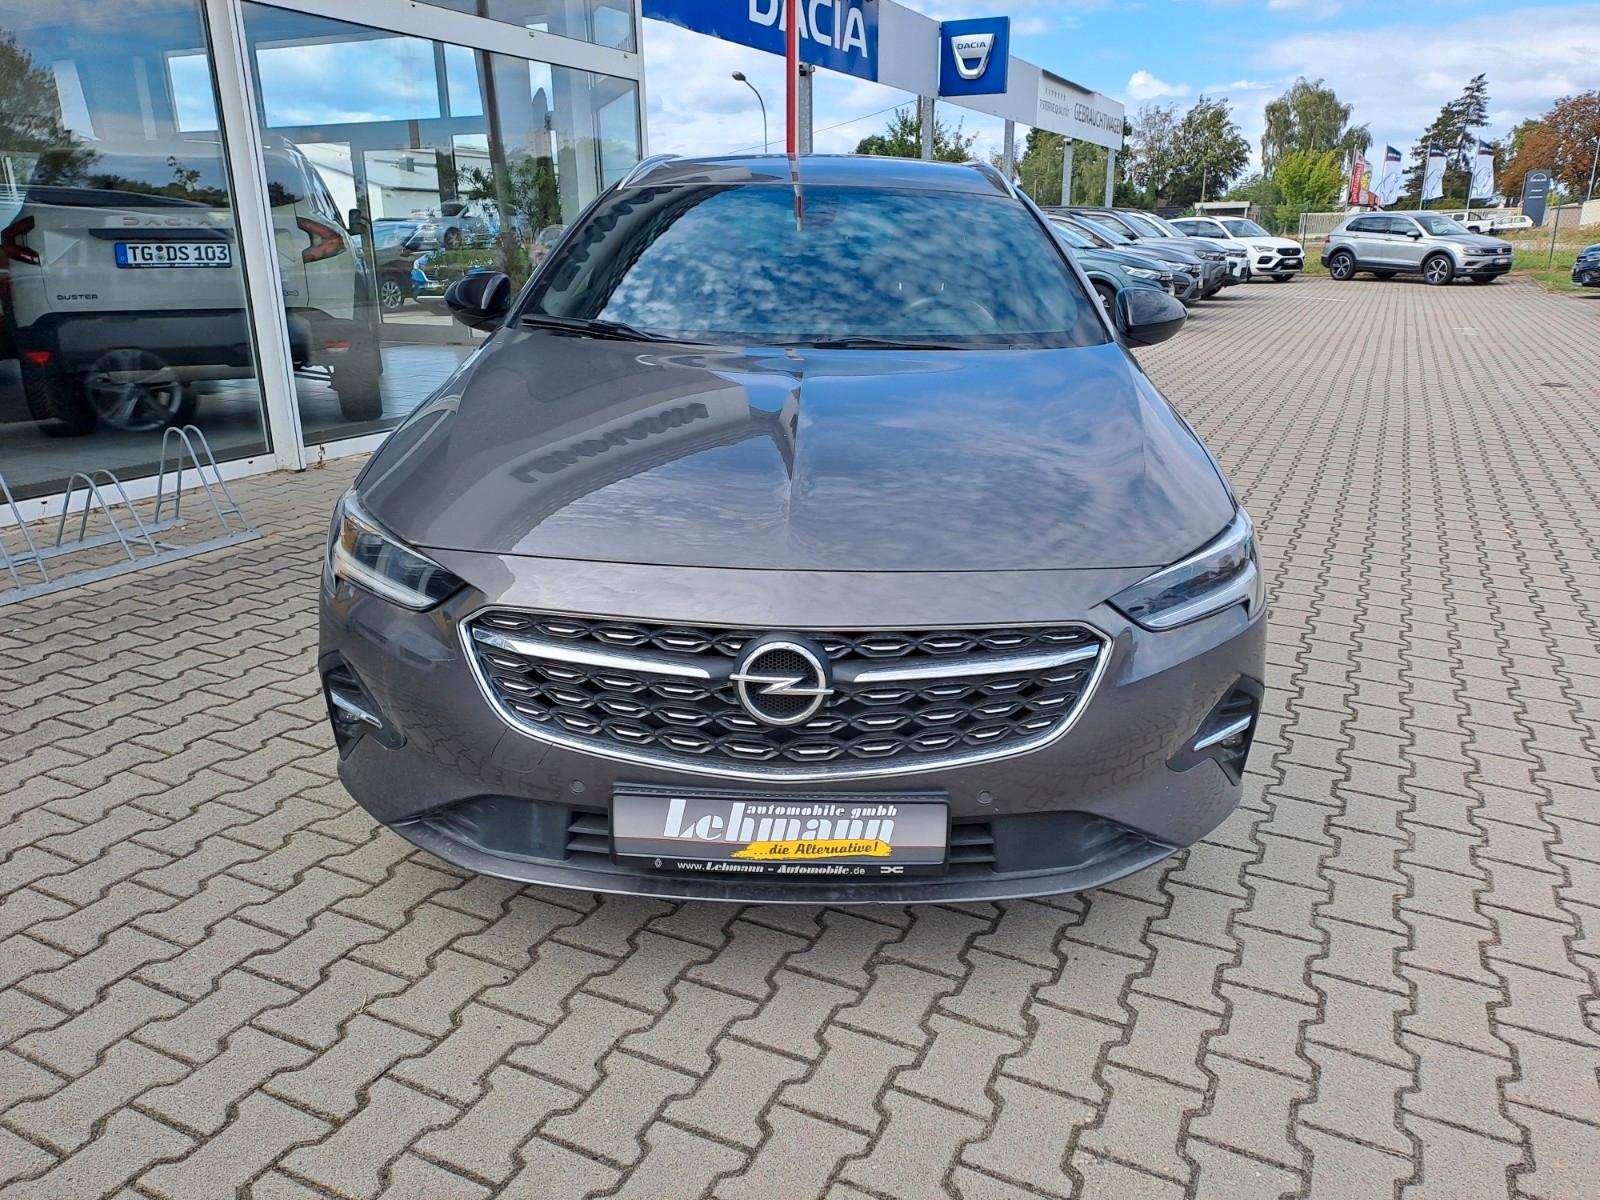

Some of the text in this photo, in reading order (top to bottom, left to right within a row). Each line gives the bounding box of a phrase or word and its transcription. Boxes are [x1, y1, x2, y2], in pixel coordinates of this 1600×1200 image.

[957, 42, 986, 50] DACIA
[128, 246, 228, 262] TG DS 103
[746, 805, 898, 819] automobile gmbh
[663, 799, 896, 844] Lehmann
[795, 841, 879, 855] Alternative!
